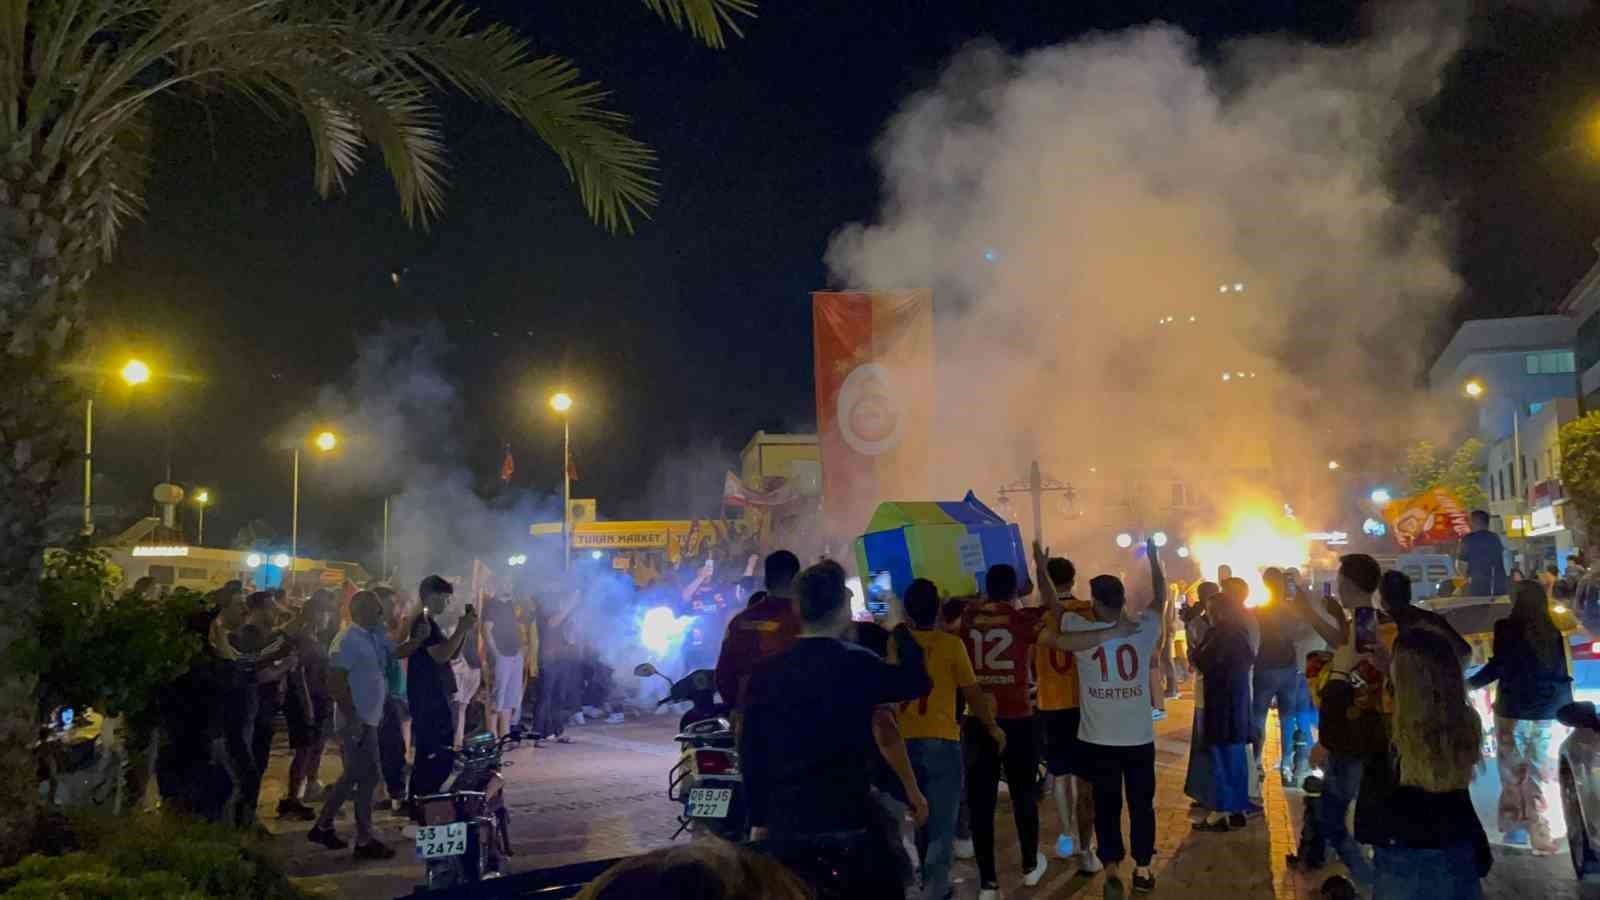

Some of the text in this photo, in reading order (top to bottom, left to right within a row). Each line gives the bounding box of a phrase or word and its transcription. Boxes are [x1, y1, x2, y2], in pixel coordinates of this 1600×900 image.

[577, 533, 660, 545] TURAN MARKET
[969, 628, 1015, 670] 12
[1092, 643, 1139, 682] 10
[1088, 685, 1143, 699] MERTENS
[696, 803, 718, 816] 727
[417, 828, 436, 841] 33
[426, 841, 464, 856] 2474
